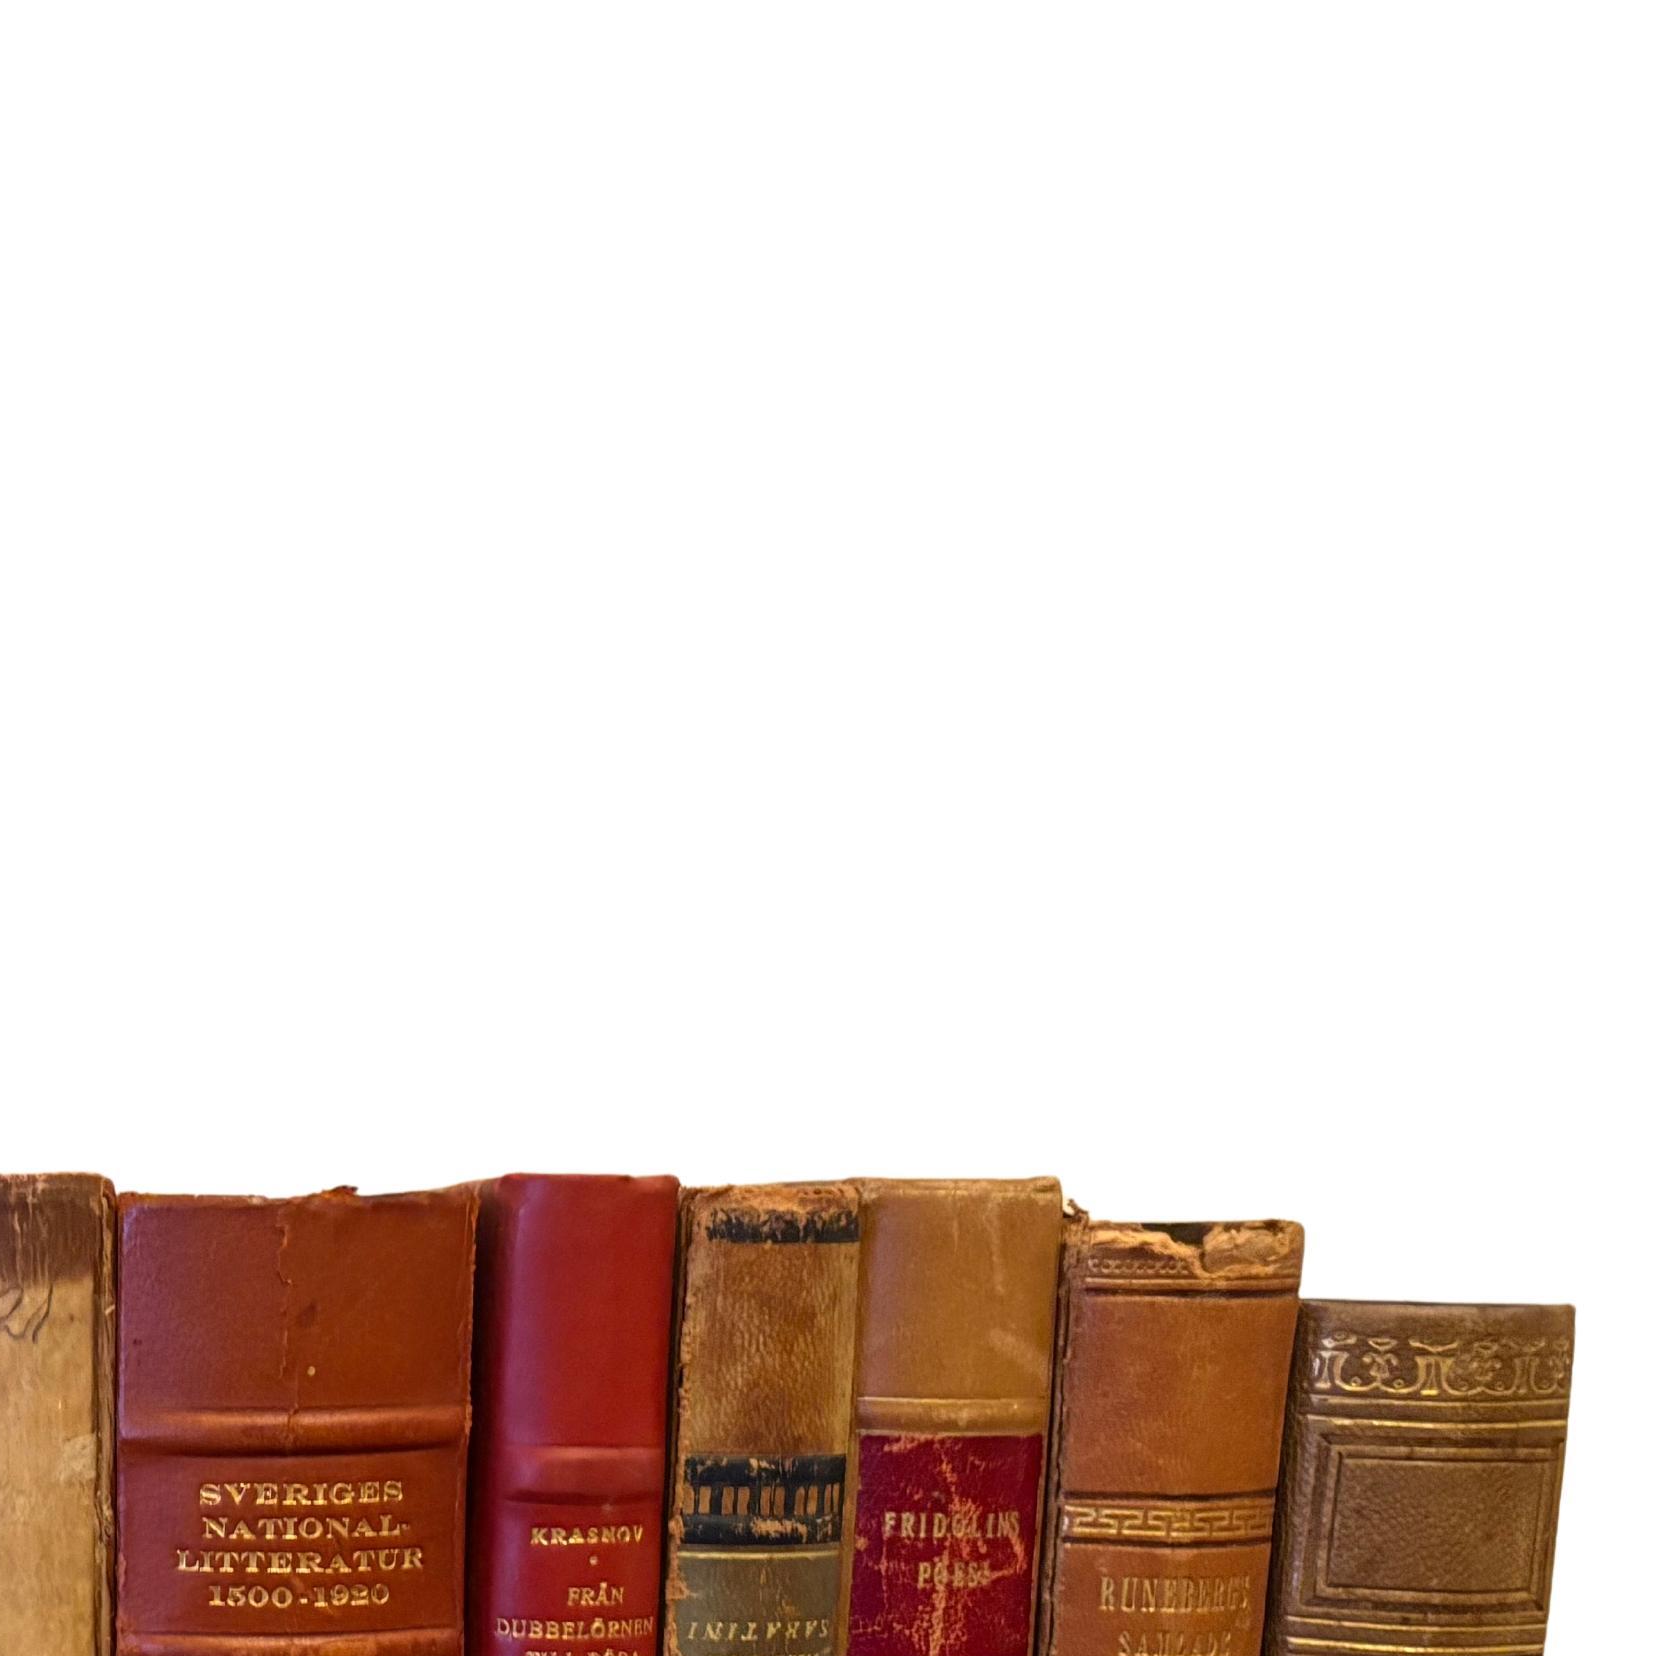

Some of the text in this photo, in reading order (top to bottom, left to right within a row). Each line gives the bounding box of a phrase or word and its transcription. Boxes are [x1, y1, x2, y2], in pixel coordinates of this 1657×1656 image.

[199, 1480, 403, 1506] SVERIGES
[530, 1525, 644, 1546] KRASNOV
[884, 1511, 1020, 1539] FRIDOLINS
[175, 1548, 423, 1574] LITTERATUR
[208, 1582, 390, 1609] 1500-1920
[567, 1581, 624, 1607] FRÅN
[495, 1616, 655, 1640] DUBBELÖRNEN
